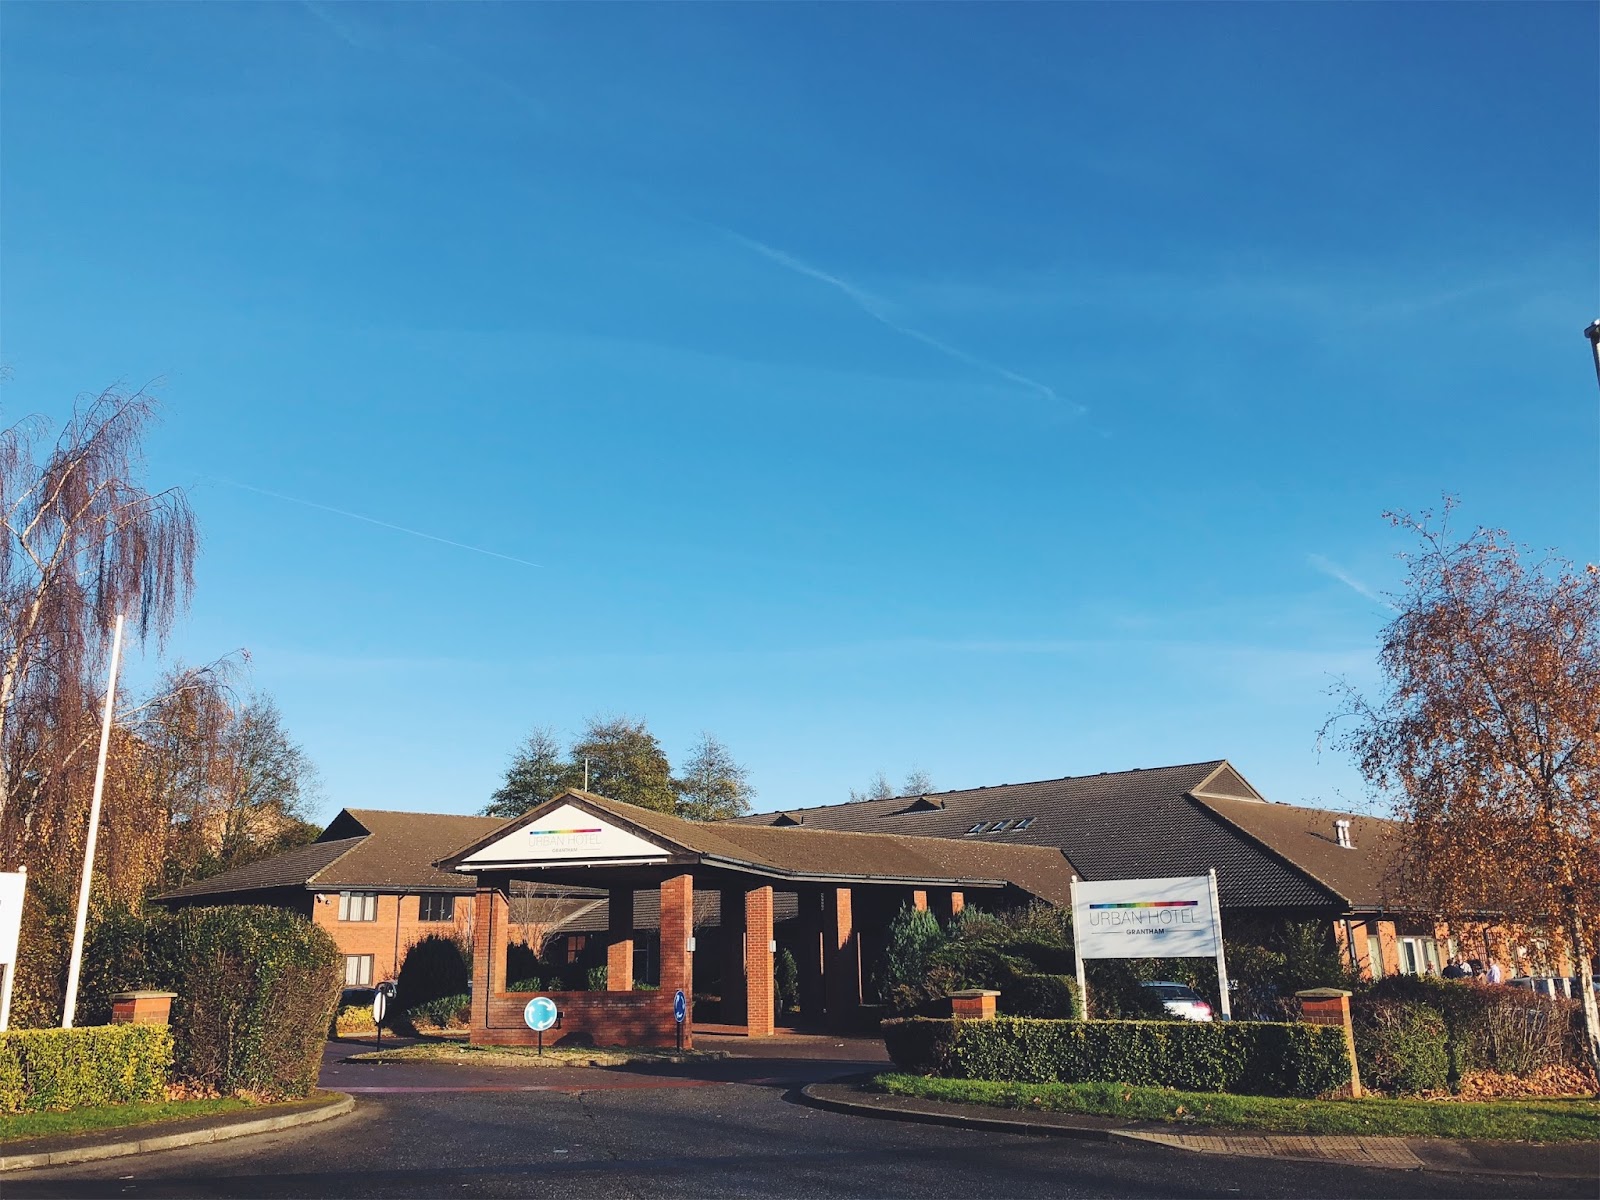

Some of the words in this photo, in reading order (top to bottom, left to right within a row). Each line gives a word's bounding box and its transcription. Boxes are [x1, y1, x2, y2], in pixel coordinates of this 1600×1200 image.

[528, 836, 564, 847] URBAN
[567, 834, 601, 845] HOTEL
[1089, 910, 1142, 926] URBAN
[1149, 908, 1201, 924] HOTEL
